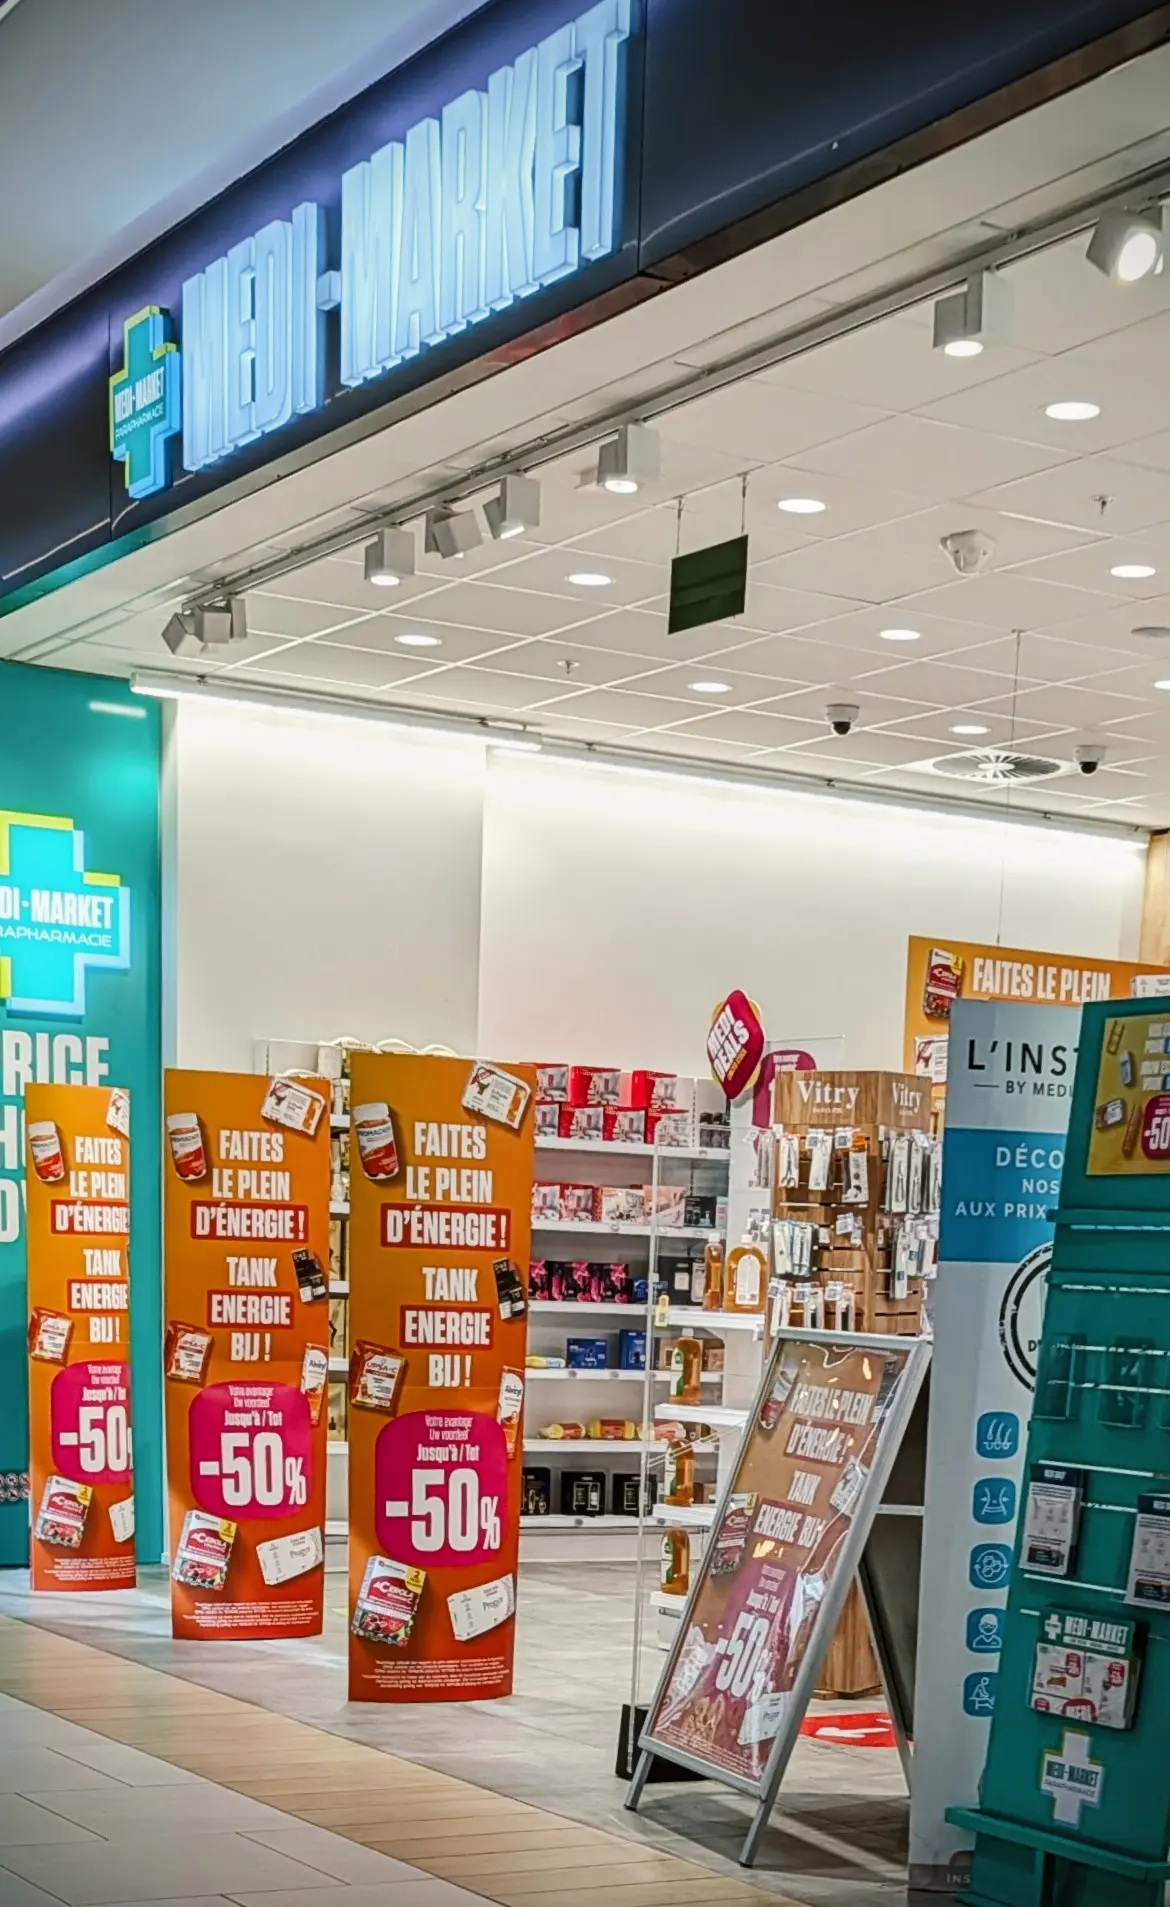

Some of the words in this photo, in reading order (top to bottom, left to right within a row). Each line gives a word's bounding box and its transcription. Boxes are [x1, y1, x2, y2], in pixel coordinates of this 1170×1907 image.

[972, 957, 1034, 998] FAITES
[1036, 966, 1056, 1001] LE
[1059, 968, 1111, 1002] PLEIN
[707, 1003, 736, 1060] MEDI
[713, 1019, 750, 1083] DEALS
[797, 1079, 860, 1110] Vitry
[891, 1081, 923, 1113] Vitry
[1005, 1080, 1025, 1096] BY
[75, 1135, 122, 1166] FAITES
[220, 1129, 285, 1163] FAITES
[414, 1121, 487, 1160] FAITES
[69, 1170, 88, 1197] LE
[90, 1171, 125, 1199] PLEIN
[212, 1168, 233, 1198] LE
[238, 1169, 290, 1201] PLEIN
[406, 1165, 431, 1200] LE
[435, 1167, 493, 1204] PLEIN
[1022, 1178, 1060, 1195] NOS
[955, 1201, 996, 1217] AUX
[1004, 1203, 1048, 1219] PRIX
[82, 1248, 122, 1276] TANK
[226, 1256, 278, 1287] TANK
[71, 1282, 128, 1310] ENERGIE
[422, 1267, 479, 1302] TANK
[211, 1294, 290, 1325] ENERGIE
[89, 1316, 113, 1343] BIJ
[404, 1310, 490, 1345] ENERGIE
[231, 1332, 260, 1361] BIJ
[428, 1354, 461, 1387] BIJ
[267, 1410, 283, 1427] Tot
[839, 1390, 875, 1425] PLEIN
[199, 1432, 307, 1506] -50%
[465, 1444, 480, 1462] Tot
[788, 1470, 822, 1506] TANK
[385, 1468, 501, 1552] -50%
[753, 1503, 803, 1544] ENERGIE
